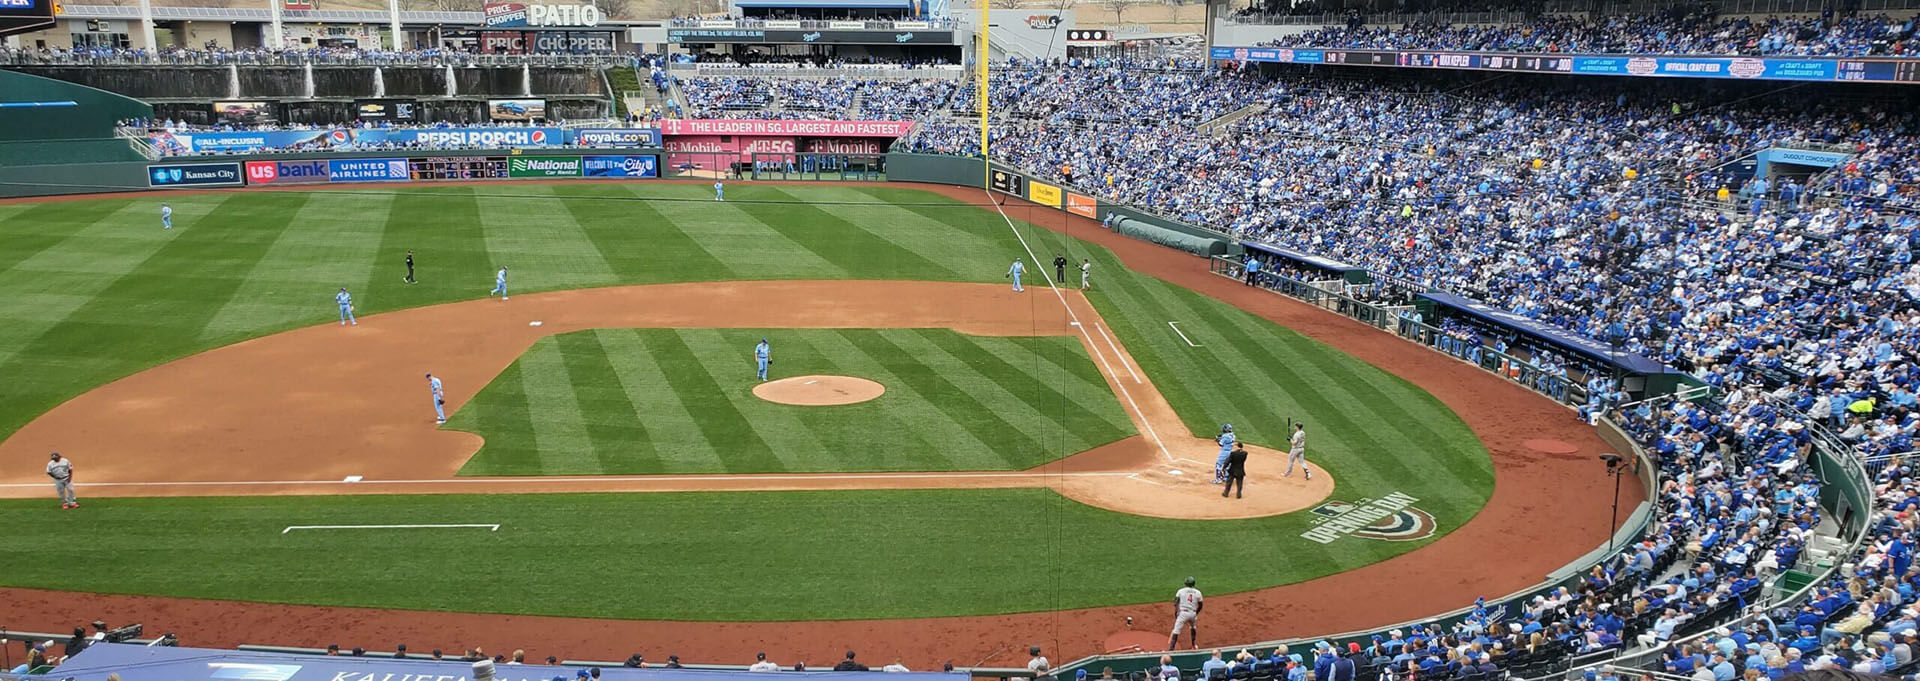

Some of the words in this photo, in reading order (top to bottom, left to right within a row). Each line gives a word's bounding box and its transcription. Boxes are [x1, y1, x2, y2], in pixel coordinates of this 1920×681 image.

[486, 4, 511, 15] PRICE
[529, 4, 600, 26] PATIO
[487, 11, 526, 25] CHOPPER
[1031, 18, 1056, 28] RIVALS
[486, 37, 529, 50] PRIC
[538, 37, 609, 50] CHOPPER
[1439, 55, 1450, 66] MAX
[1450, 55, 1470, 67] KEPLER
[1665, 63, 1687, 72] OFFICIAL
[1688, 63, 1705, 72] CRAFT
[1706, 64, 1721, 72] BEER
[668, 119, 681, 134] T
[690, 122, 711, 132] THE
[713, 122, 752, 133] LEADER
[754, 122, 766, 133] IN
[768, 123, 784, 133] 5G.
[786, 123, 832, 134] LARGEST
[834, 123, 856, 134] AND
[858, 124, 902, 135] FASTEST.
[201, 138, 264, 146] ALL-INCLUSIVE
[417, 132, 466, 144] PEPSI
[470, 131, 528, 145] PORCH
[583, 132, 650, 144] royals.com
[680, 140, 722, 152] Mobile
[772, 140, 795, 153] 5G
[251, 165, 275, 178] us
[278, 161, 326, 177] bank
[527, 159, 578, 170] National
[585, 160, 605, 169] WELCOME
[607, 160, 613, 169] TO
[622, 158, 646, 175] City
[185, 170, 216, 179] Kansas
[218, 170, 235, 181] City
[331, 170, 386, 178] AIRLINES
[1300, 505, 1392, 544] OPENING
[1372, 491, 1420, 511] DAY
